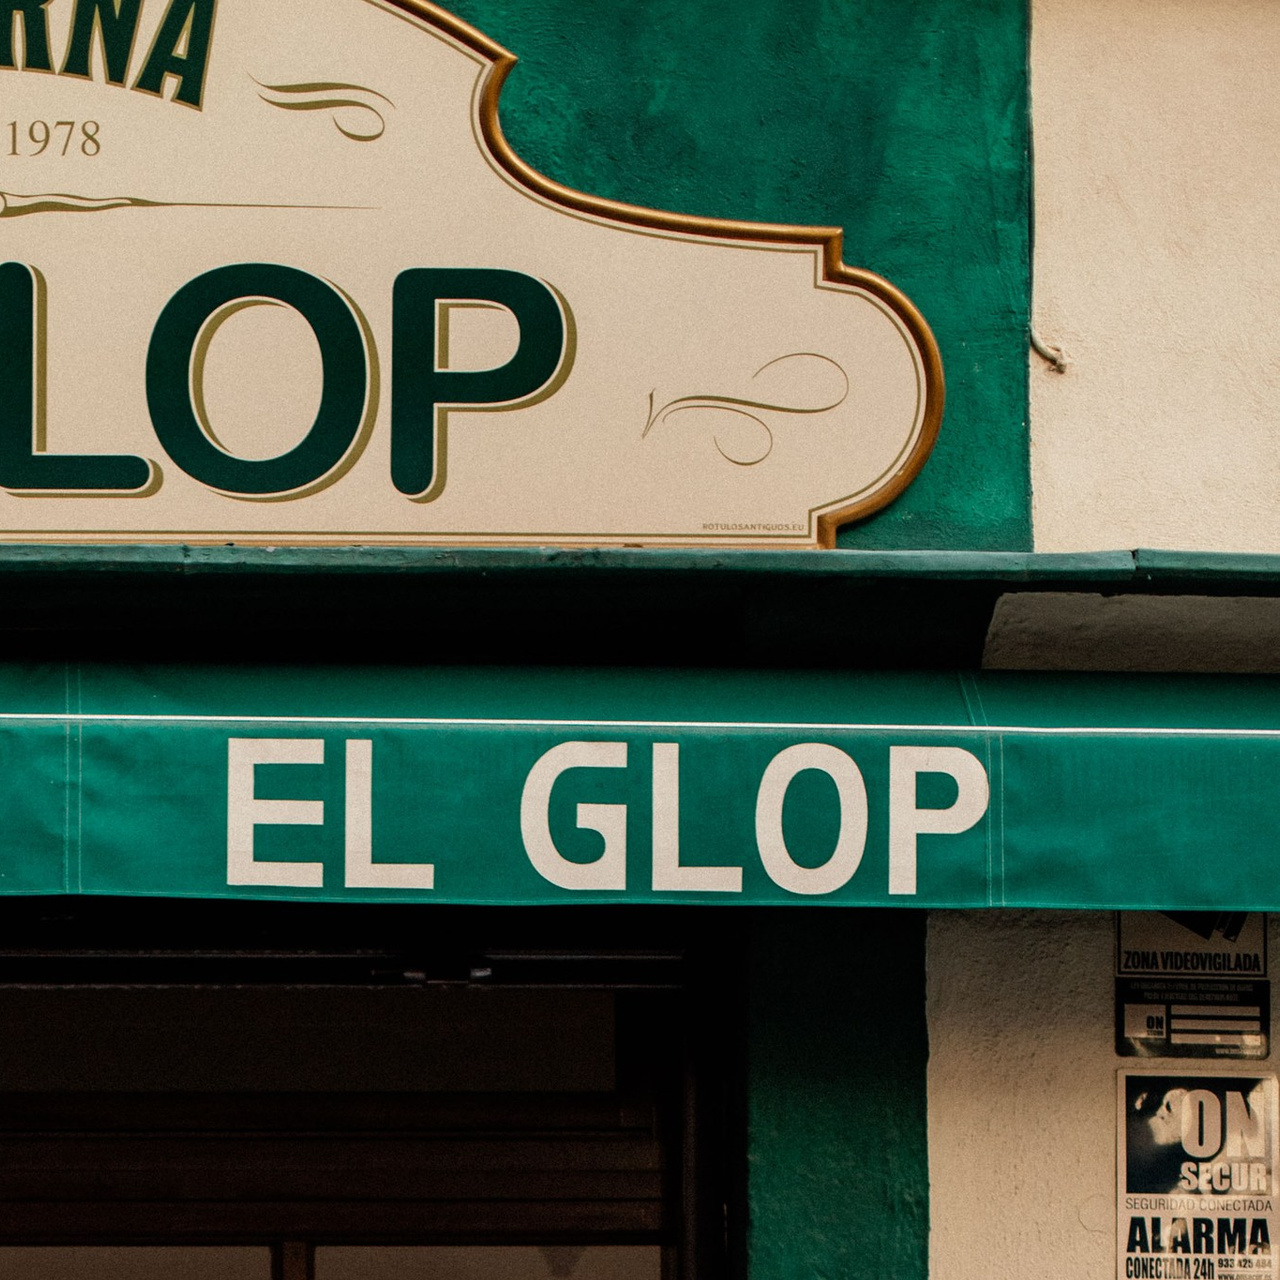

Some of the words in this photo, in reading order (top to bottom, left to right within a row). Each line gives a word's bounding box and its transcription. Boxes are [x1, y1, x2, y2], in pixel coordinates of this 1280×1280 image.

[7, 120, 101, 158] 1978
[227, 736, 435, 891] EL
[520, 740, 990, 897] GLOP
[1123, 951, 1159, 970] ZONA
[1161, 952, 1261, 972] VIDEOVIGILADA
[1146, 1015, 1164, 1030] ON
[1181, 1088, 1266, 1158] ON
[1180, 1161, 1267, 1192] SECUR
[1125, 1197, 1196, 1212] SEGURIDAD
[1198, 1199, 1273, 1213] CONECTADA
[1126, 1216, 1272, 1255] ALARMA
[1126, 1256, 1192, 1280] CONECTADA
[1193, 1257, 1215, 1280] 24h
